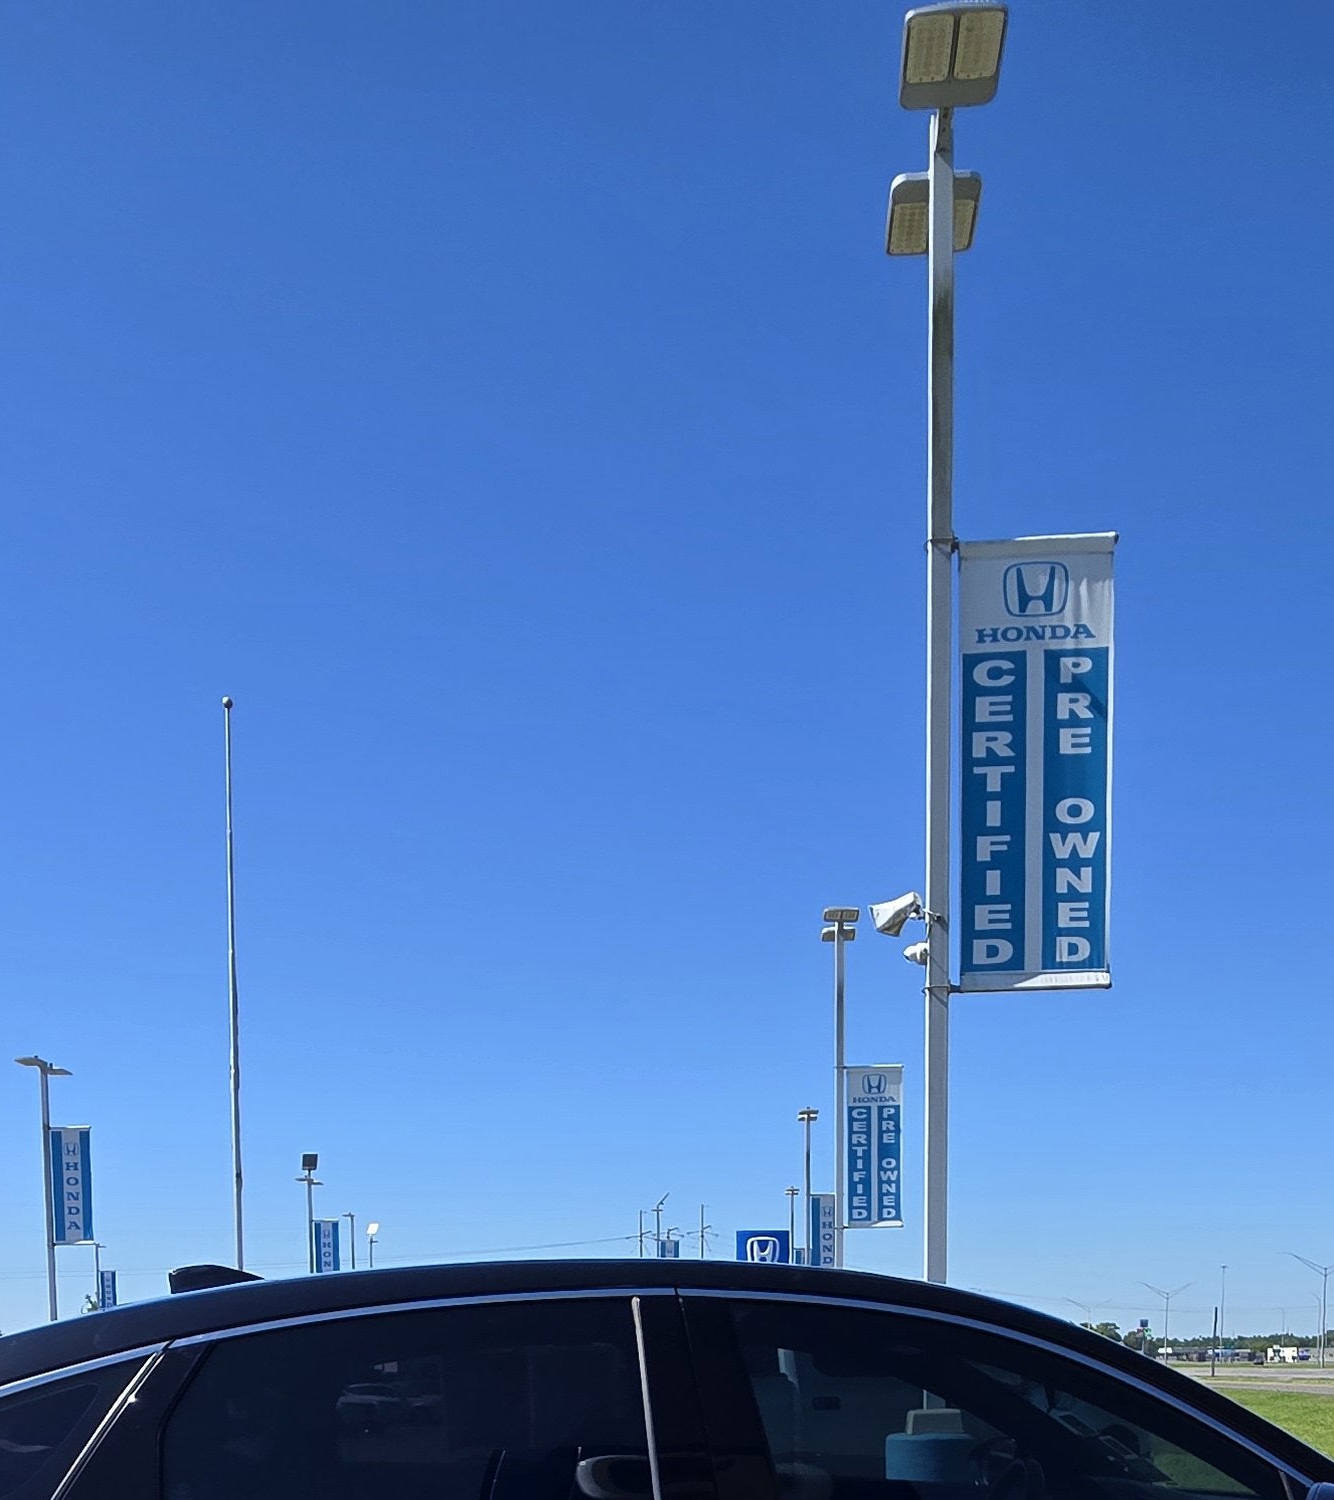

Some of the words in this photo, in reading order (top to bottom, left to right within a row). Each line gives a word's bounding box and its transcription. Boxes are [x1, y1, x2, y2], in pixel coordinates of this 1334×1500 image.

[975, 623, 1096, 644] HONDA
[1056, 656, 1093, 754] PRE
[972, 659, 1016, 965] CERTIFIED
[1048, 797, 1101, 962] OWNED
[852, 1096, 896, 1104] HONDA
[882, 1107, 896, 1144] PRE
[65, 1161, 81, 1231] HONDA
[851, 1108, 868, 1220] CERTIFIED
[880, 1158, 898, 1219] OWNED
